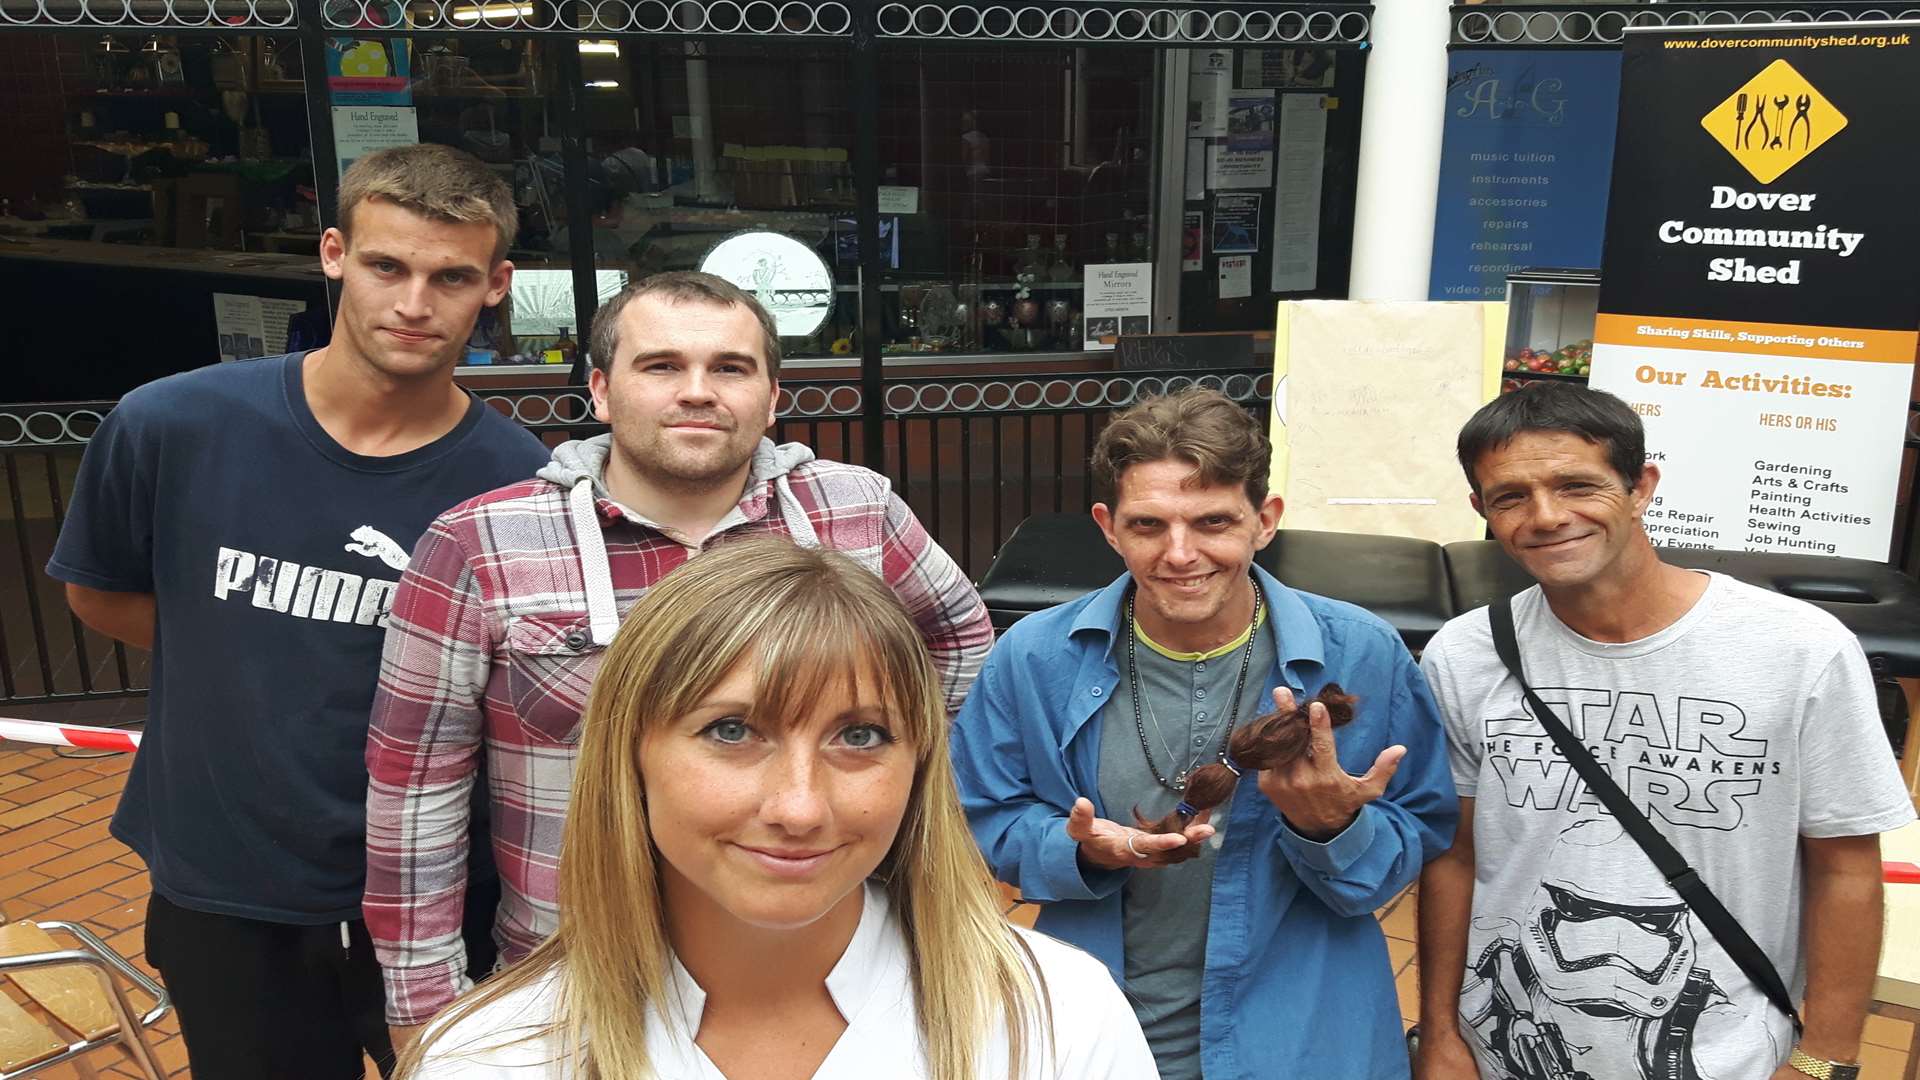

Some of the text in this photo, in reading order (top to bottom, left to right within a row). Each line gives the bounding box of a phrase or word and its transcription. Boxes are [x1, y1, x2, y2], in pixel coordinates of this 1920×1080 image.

[1664, 34, 1910, 50] www.dovercommunityshed.org.uk
[1471, 153, 1555, 162] music tuition
[1472, 175, 1549, 186] instruments
[1469, 197, 1547, 208] accessories
[1710, 186, 1816, 211] Dover
[1483, 219, 1528, 229] repairs
[1471, 242, 1532, 251] rehearsal
[1658, 221, 1864, 257] Community
[1708, 258, 1800, 285] Shed
[1445, 285, 1480, 295] video
[1636, 325, 1864, 348] Sharing Skills, Supporting Others
[1635, 365, 1852, 398] Our Activities:
[1630, 402, 1661, 417] HERS
[1759, 413, 1837, 432] HERS OR HIS
[1754, 460, 1832, 478] Gardening
[1752, 475, 1849, 494] Arts & Crafts
[1751, 490, 1811, 506] Painting
[1668, 509, 1714, 525] Repair
[1749, 504, 1871, 526] Health Activities
[1644, 524, 1719, 539] ppreciation
[1747, 518, 1801, 535] Sewing
[1746, 533, 1836, 553] Job Hunting
[214, 546, 400, 628] PUMA
[1485, 687, 1768, 758] STAR
[1480, 740, 1781, 775] HE FOCE AWAKENS
